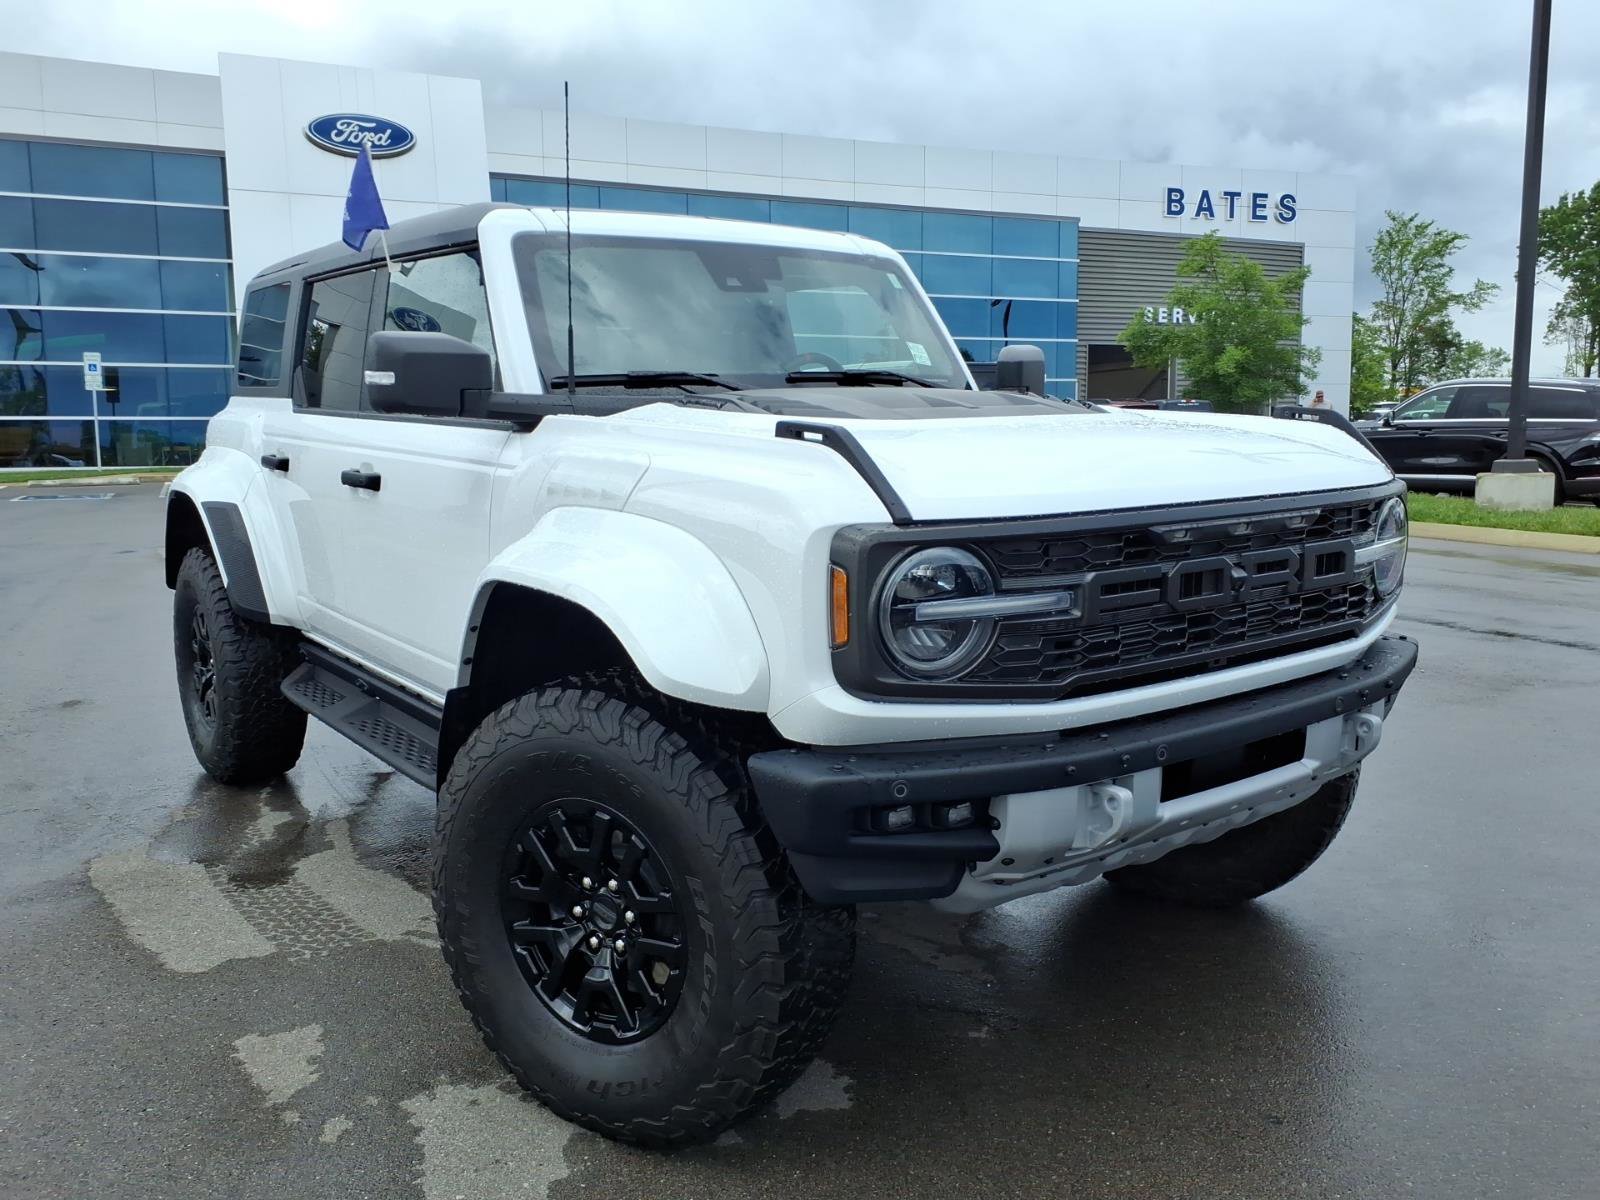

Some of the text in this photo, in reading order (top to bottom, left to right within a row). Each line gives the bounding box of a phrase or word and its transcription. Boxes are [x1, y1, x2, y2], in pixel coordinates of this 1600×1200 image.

[330, 119, 393, 146] Ford
[1164, 186, 1298, 223] BATES
[1083, 537, 1348, 627] FORD
